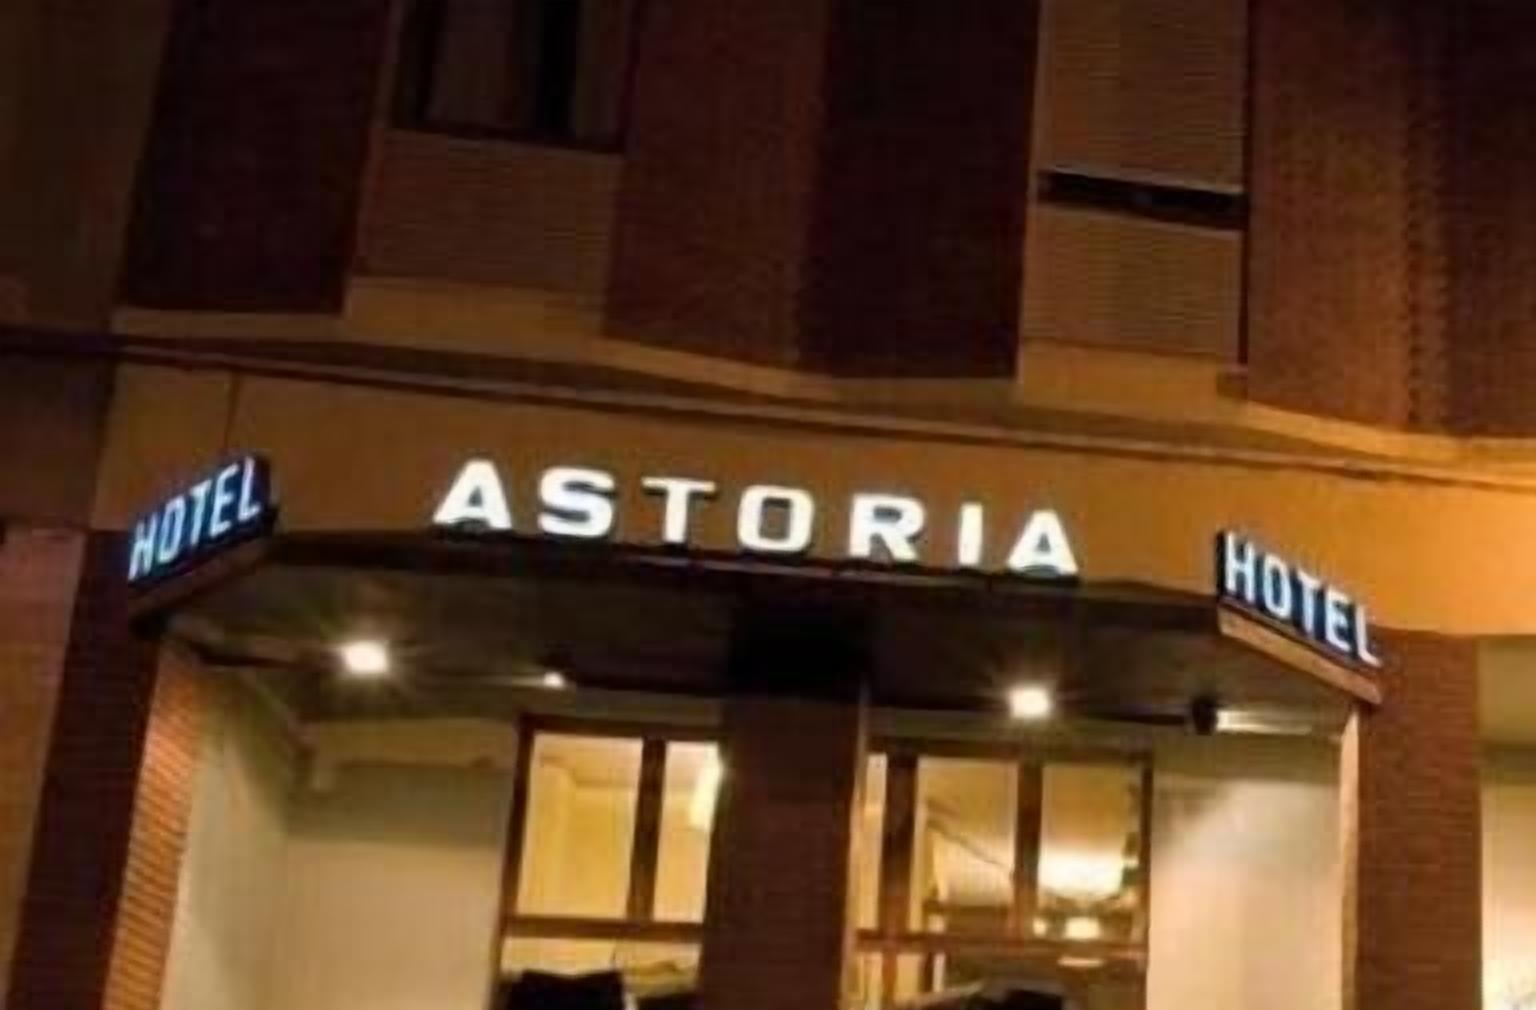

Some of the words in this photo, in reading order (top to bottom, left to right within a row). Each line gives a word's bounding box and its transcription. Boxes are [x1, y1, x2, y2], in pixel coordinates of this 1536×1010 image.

[127, 455, 264, 582] HOTEL
[432, 458, 1079, 577] ASTORIA
[1222, 530, 1383, 667] HOTEL
